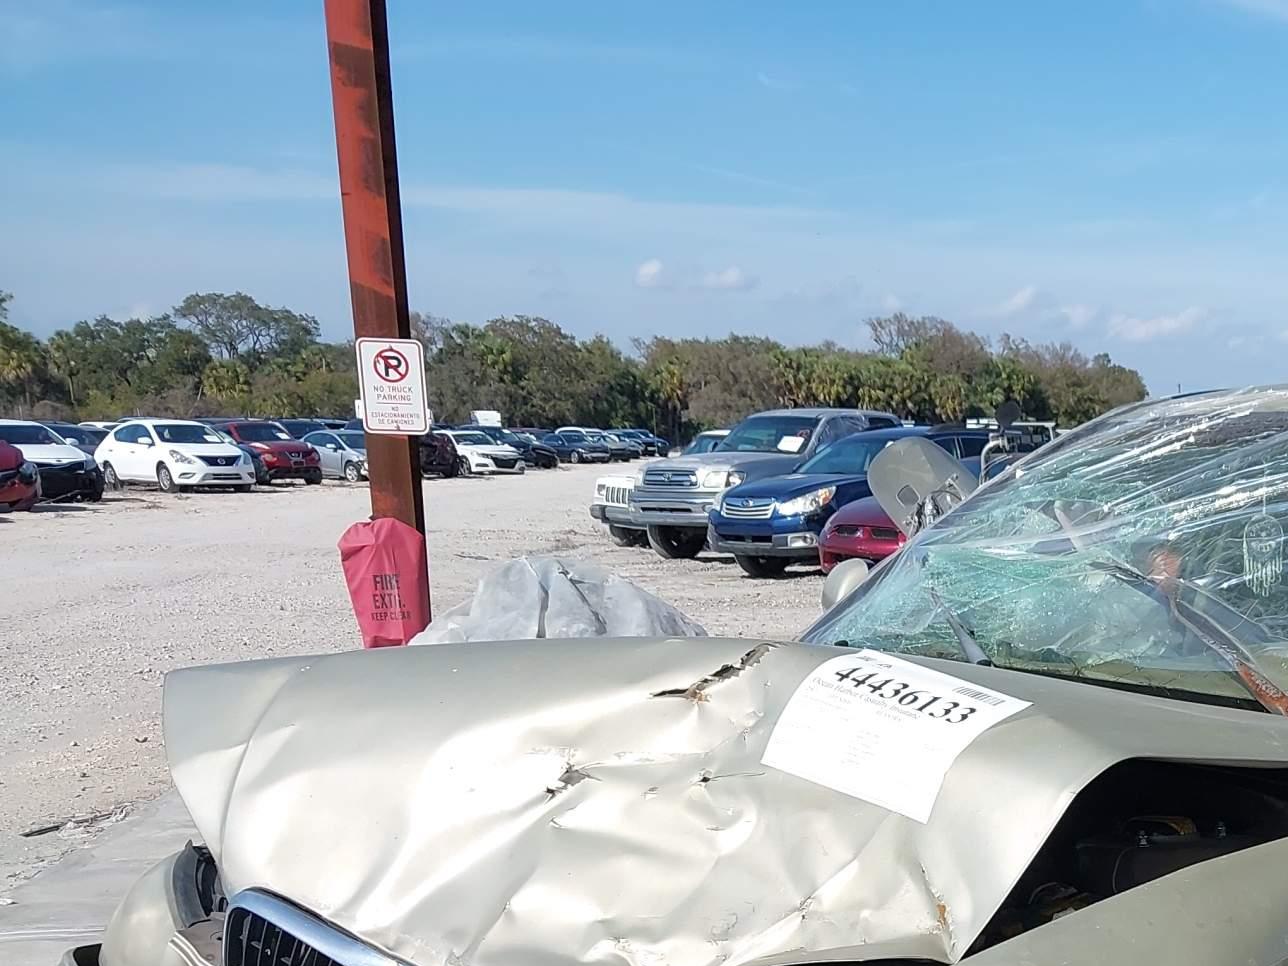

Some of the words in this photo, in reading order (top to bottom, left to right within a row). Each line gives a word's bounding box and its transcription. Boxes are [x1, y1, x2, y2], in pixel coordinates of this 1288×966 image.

[373, 385, 384, 393] NO
[387, 385, 413, 393] TRUCK
[376, 393, 412, 401] PARKING
[372, 574, 400, 590] FIRE
[834, 666, 978, 724] 44436133
